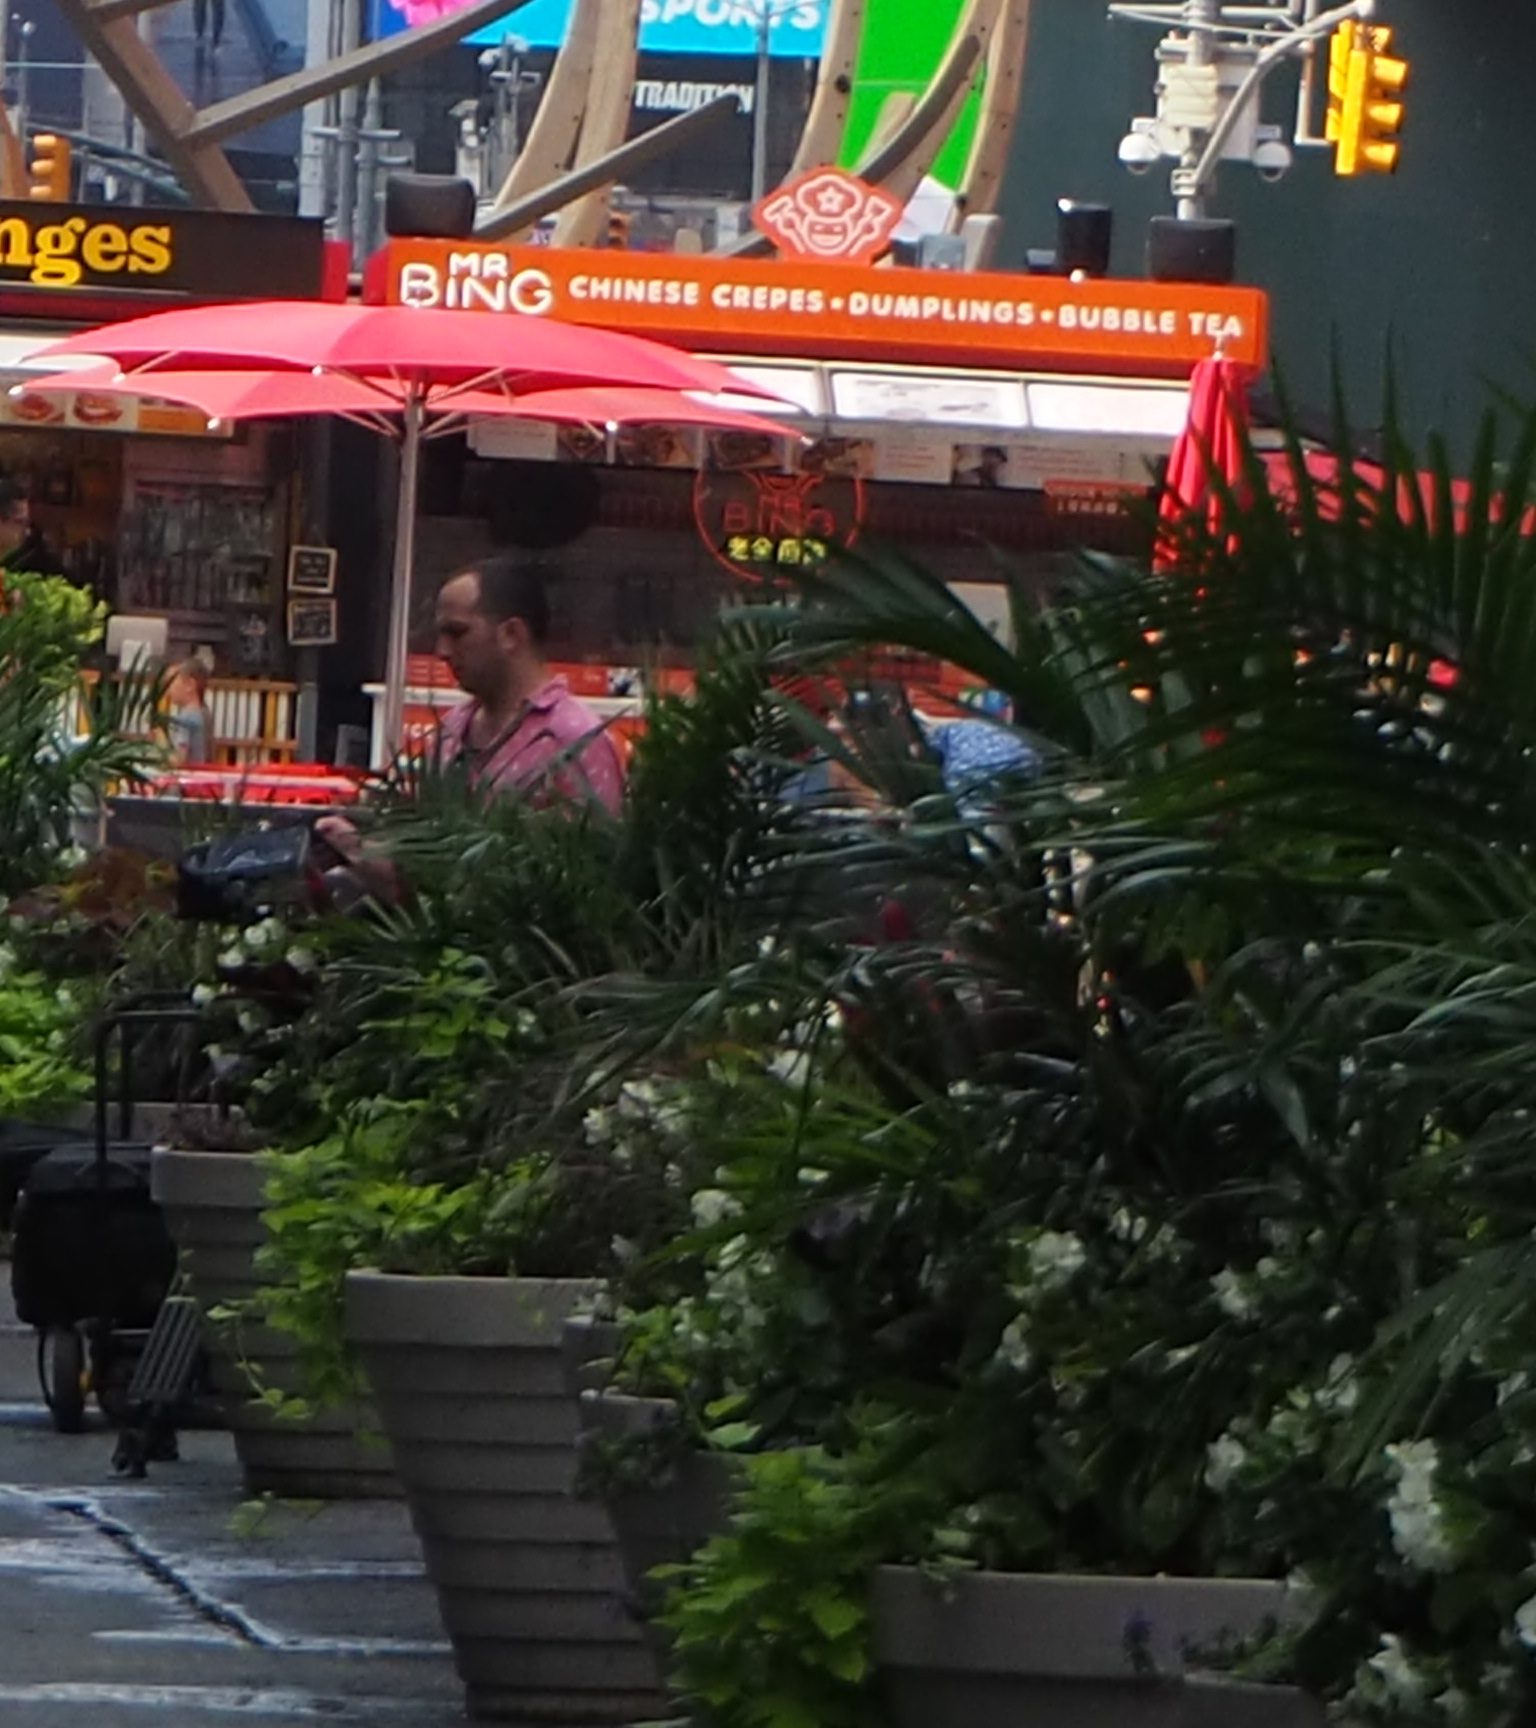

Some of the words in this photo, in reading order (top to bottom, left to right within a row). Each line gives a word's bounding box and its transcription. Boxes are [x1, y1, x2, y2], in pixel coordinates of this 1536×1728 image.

[449, 253, 509, 279] MR
[400, 263, 554, 316] BING
[569, 274, 699, 306] CHINESE
[712, 283, 825, 314] CREPES
[848, 292, 1035, 327] DUMPLINGS
[1057, 305, 1176, 335] BUBBLE
[1188, 313, 1243, 339] TEA
